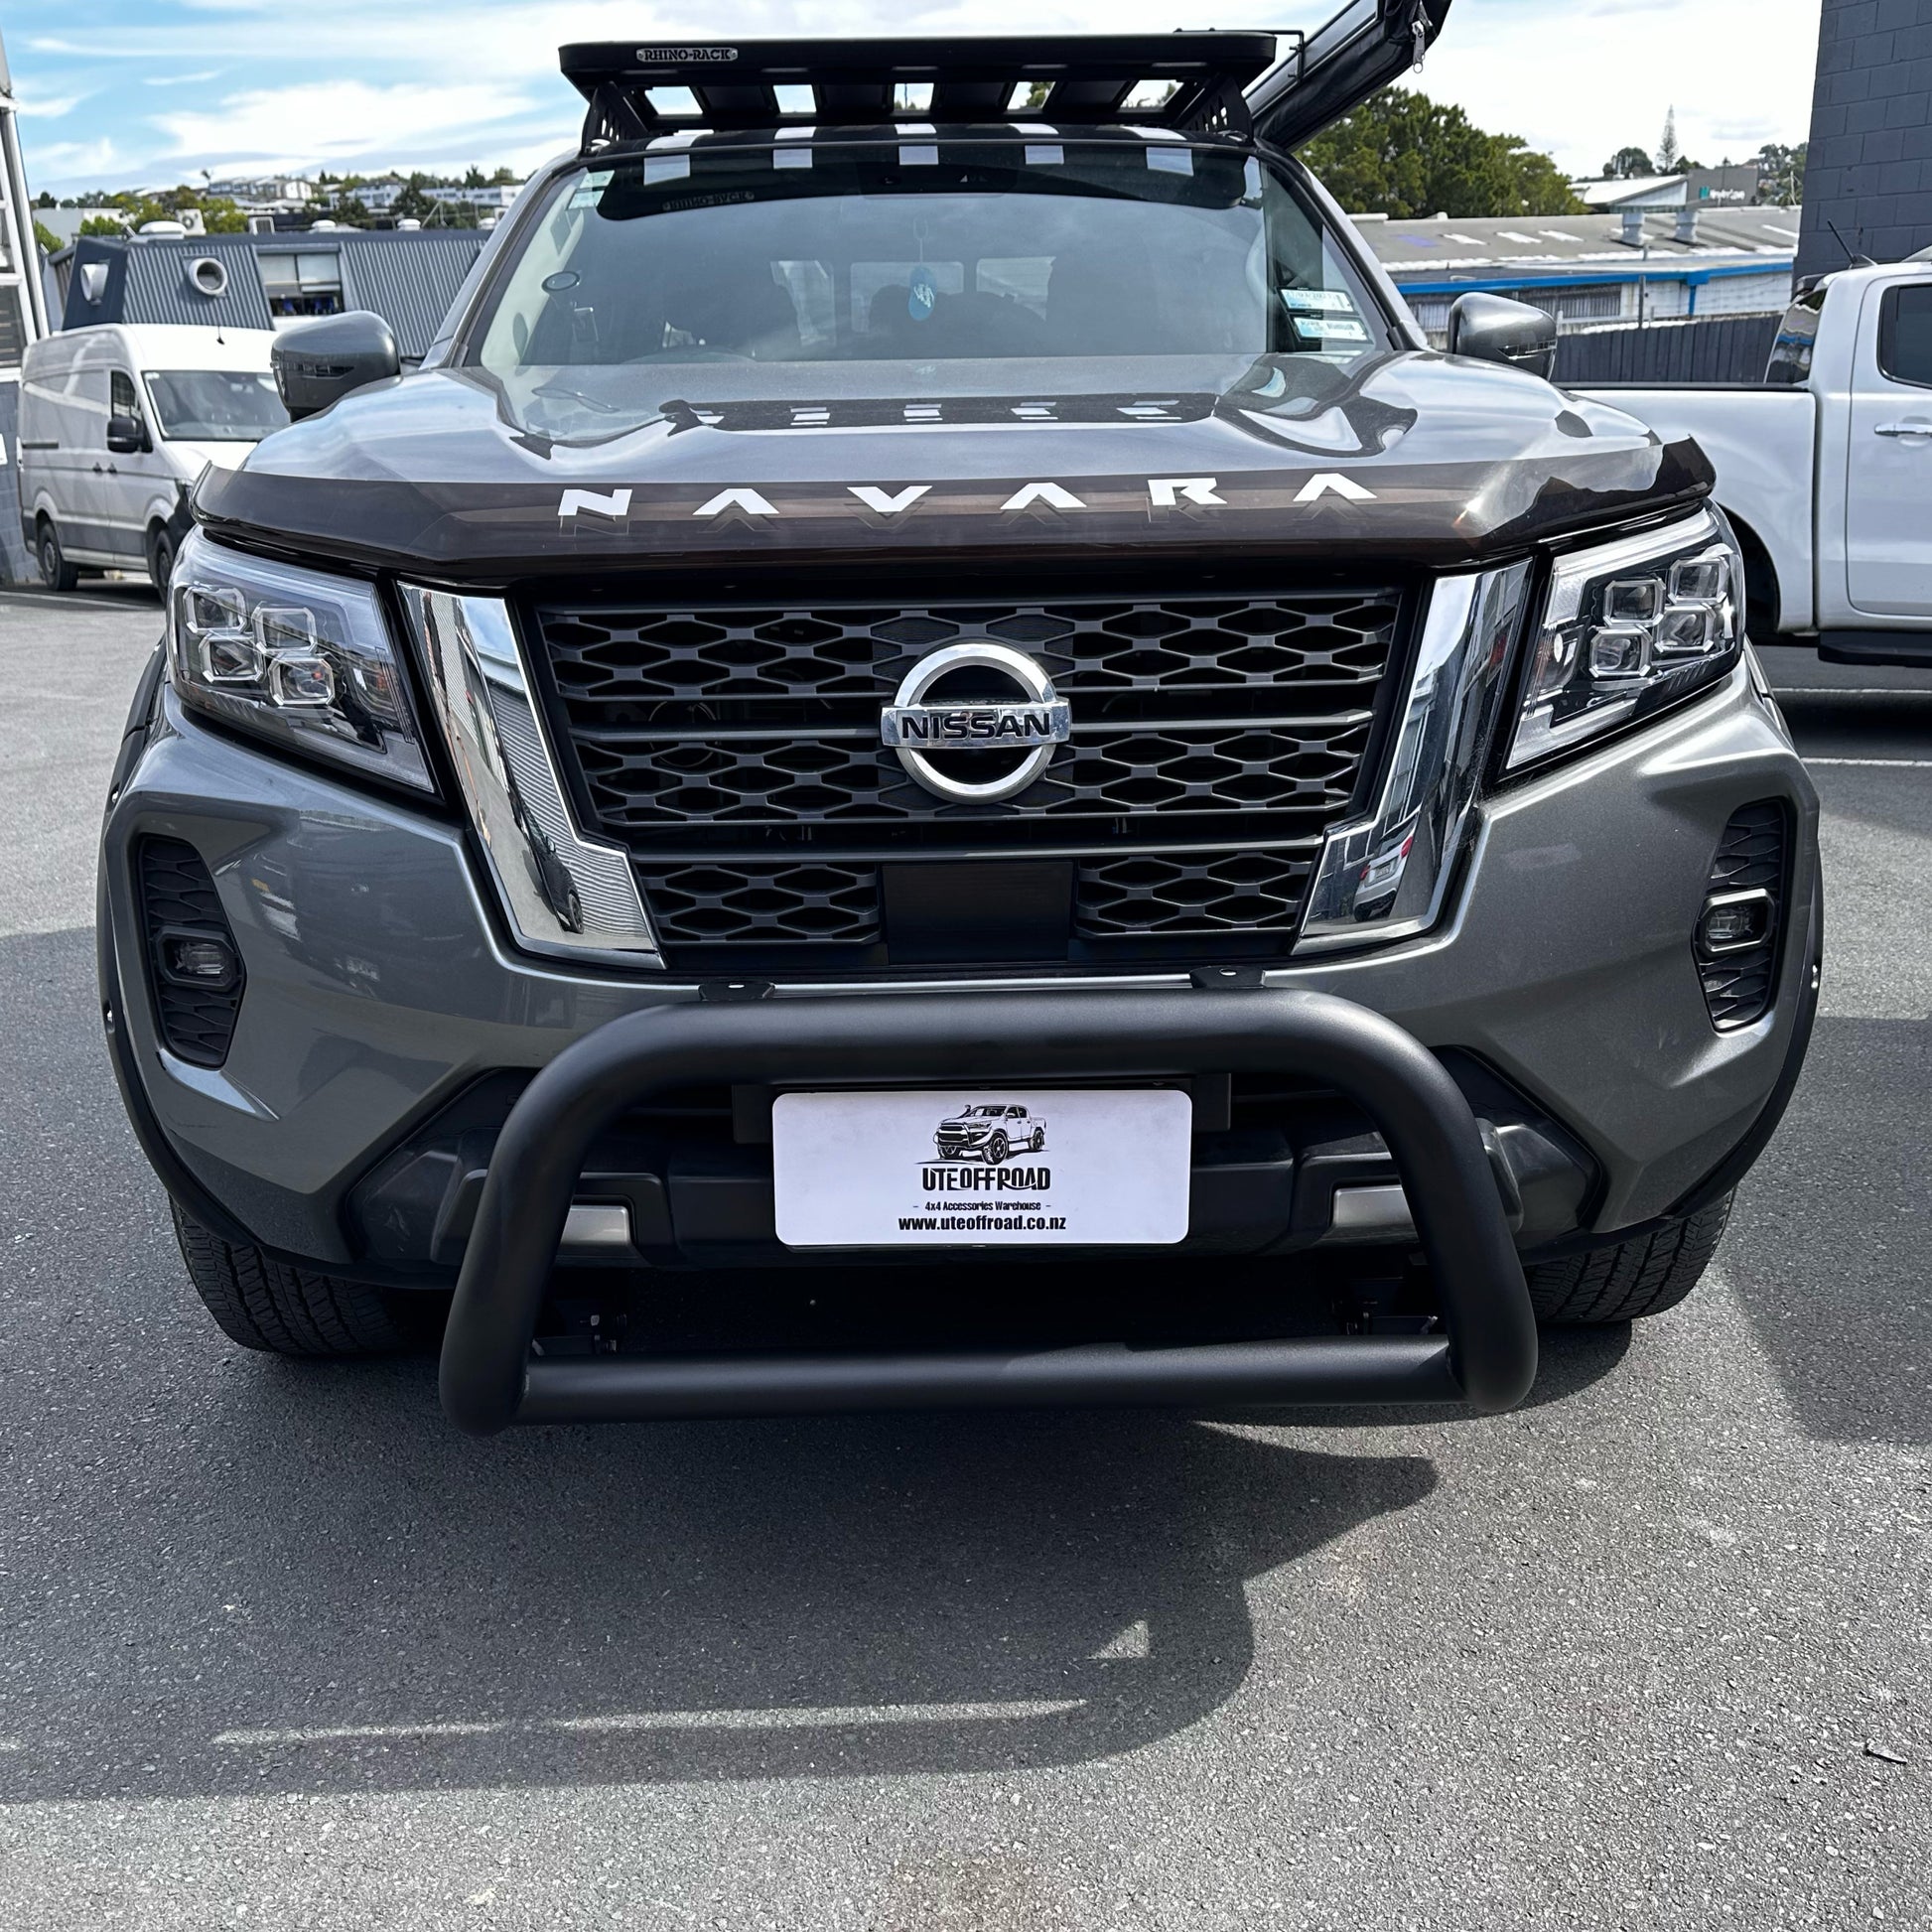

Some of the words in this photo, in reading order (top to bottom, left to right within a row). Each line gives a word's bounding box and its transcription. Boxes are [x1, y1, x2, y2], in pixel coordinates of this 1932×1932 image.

[643, 49, 731, 61] RHINO-RACK
[558, 473, 1378, 516] NAVARA
[901, 712, 1050, 740] NISSAN
[922, 1167, 1051, 1191] UTEOFFROAD
[924, 1201, 941, 1211] 4x4
[942, 1200, 994, 1211] Accessories
[995, 1200, 1041, 1211] Warehouse
[897, 1214, 1067, 1231] www.uteoffroad.co.nz
